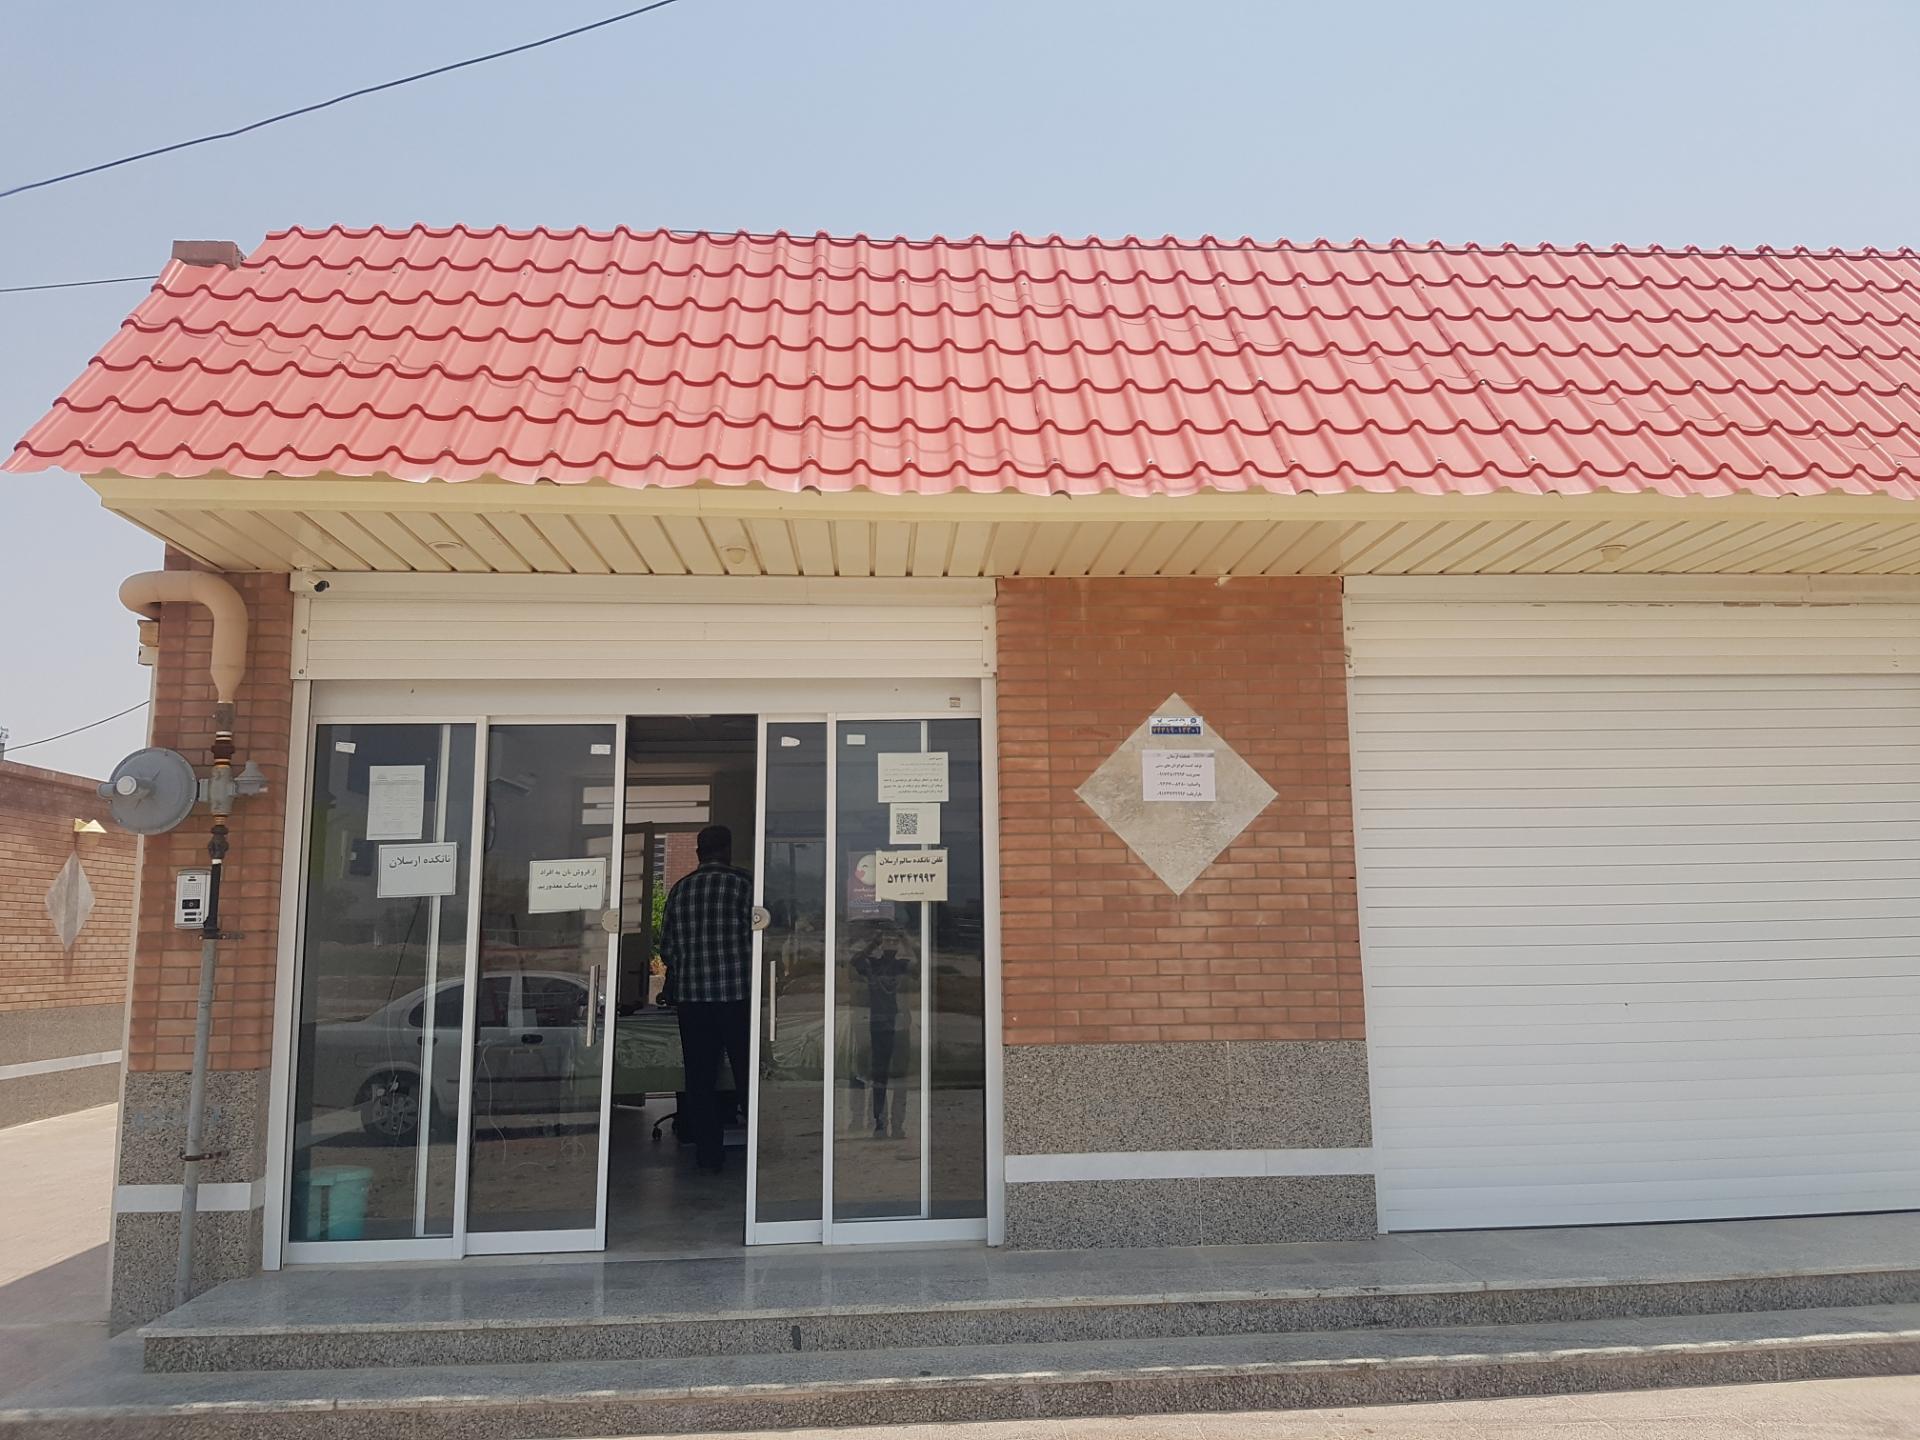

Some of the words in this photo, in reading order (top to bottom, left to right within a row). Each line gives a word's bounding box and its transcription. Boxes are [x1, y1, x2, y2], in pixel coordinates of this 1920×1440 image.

[389, 856, 421, 868] ارسلان
[423, 854, 451, 864] نانکده
[880, 856, 899, 866] ارسلان
[932, 856, 943, 864] تلفن
[540, 868, 555, 876] افراد
[572, 868, 591, 877] فروش
[591, 868, 597, 876] از
